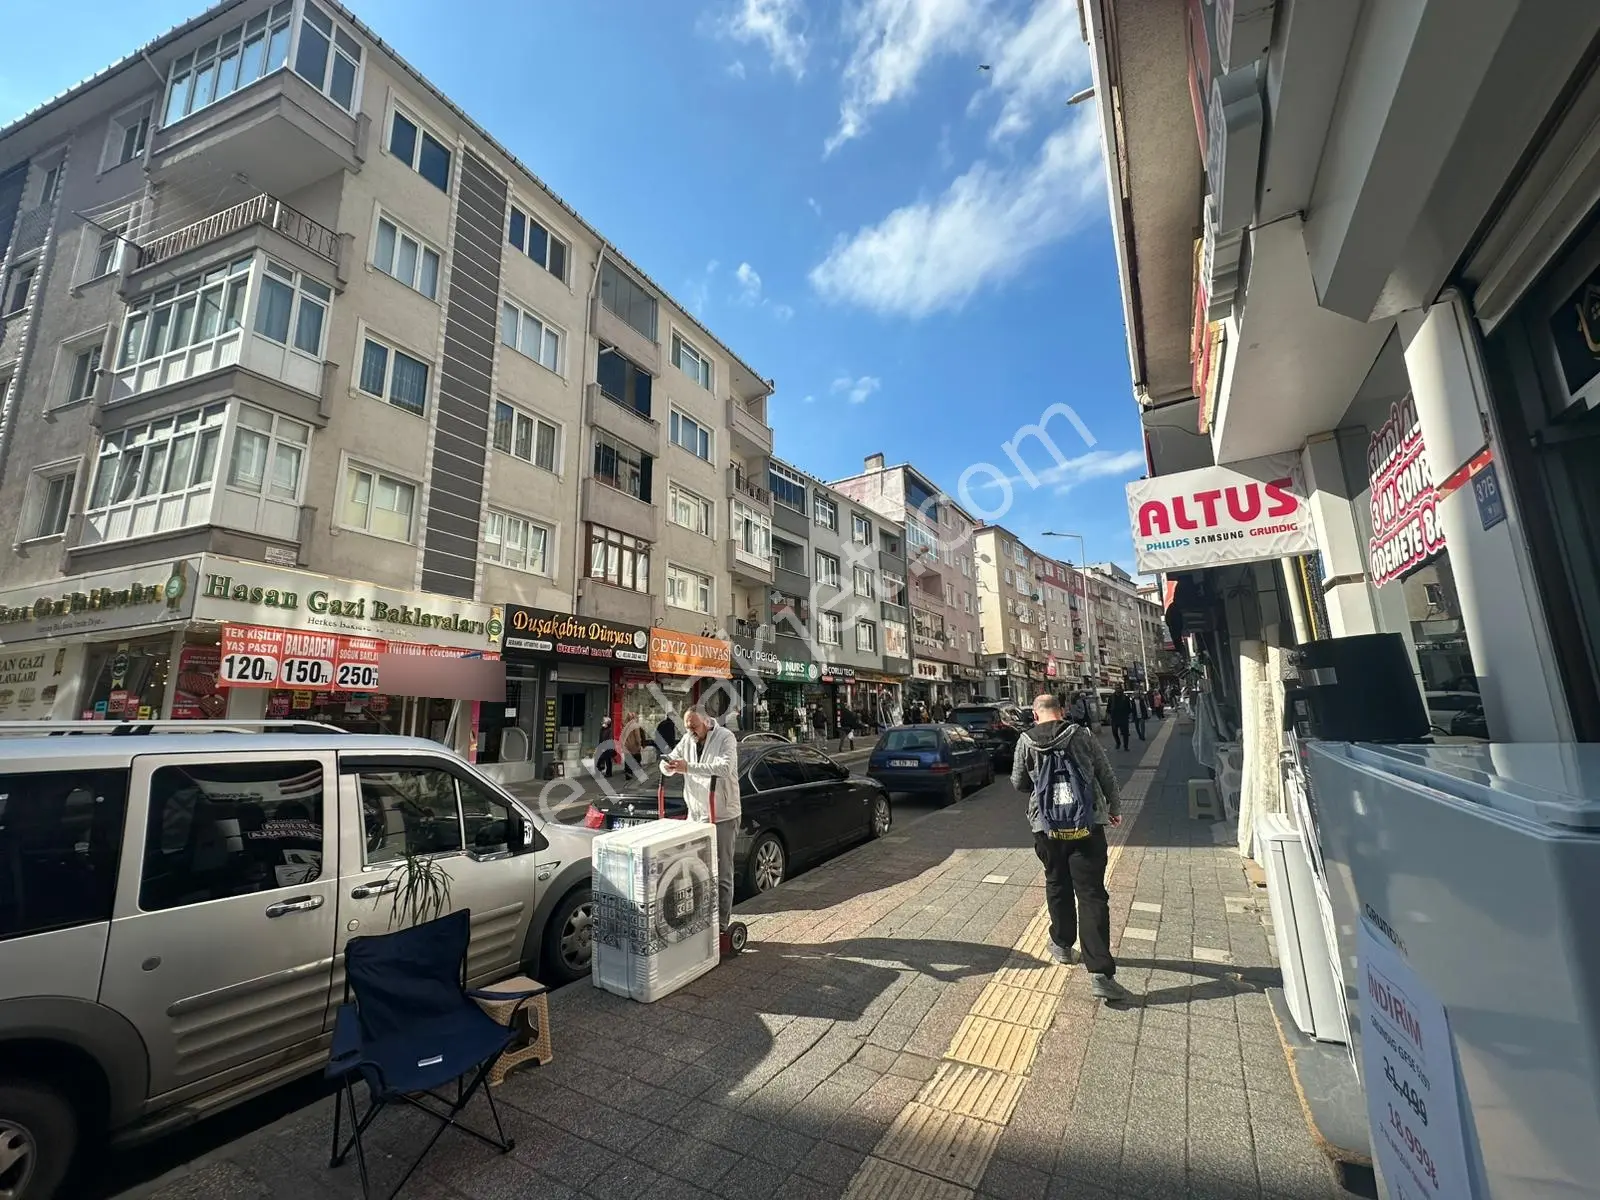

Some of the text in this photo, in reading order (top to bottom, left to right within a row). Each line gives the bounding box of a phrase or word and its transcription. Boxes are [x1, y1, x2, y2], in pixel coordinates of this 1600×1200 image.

[1372, 451, 1434, 530] 3 AY SONR
[1476, 475, 1495, 503] 37B
[1138, 477, 1298, 537] ALTUS
[1146, 522, 1298, 552] PHILIPS SAMSUNG GRUNDIG
[1372, 500, 1445, 579] ÖDEMEYE BA
[202, 573, 484, 636] Hasan Gazi Baklavaları
[224, 627, 283, 642] TEK KİŞİLİK
[513, 610, 633, 648] Duşakabin Dünyası
[18, 653, 46, 670] GAZİ
[226, 641, 278, 654] YAŞ PASTA
[284, 634, 336, 659] BALBADEM
[734, 644, 778, 665] Onur perde
[1367, 963, 1424, 1051] İNDİRİM
